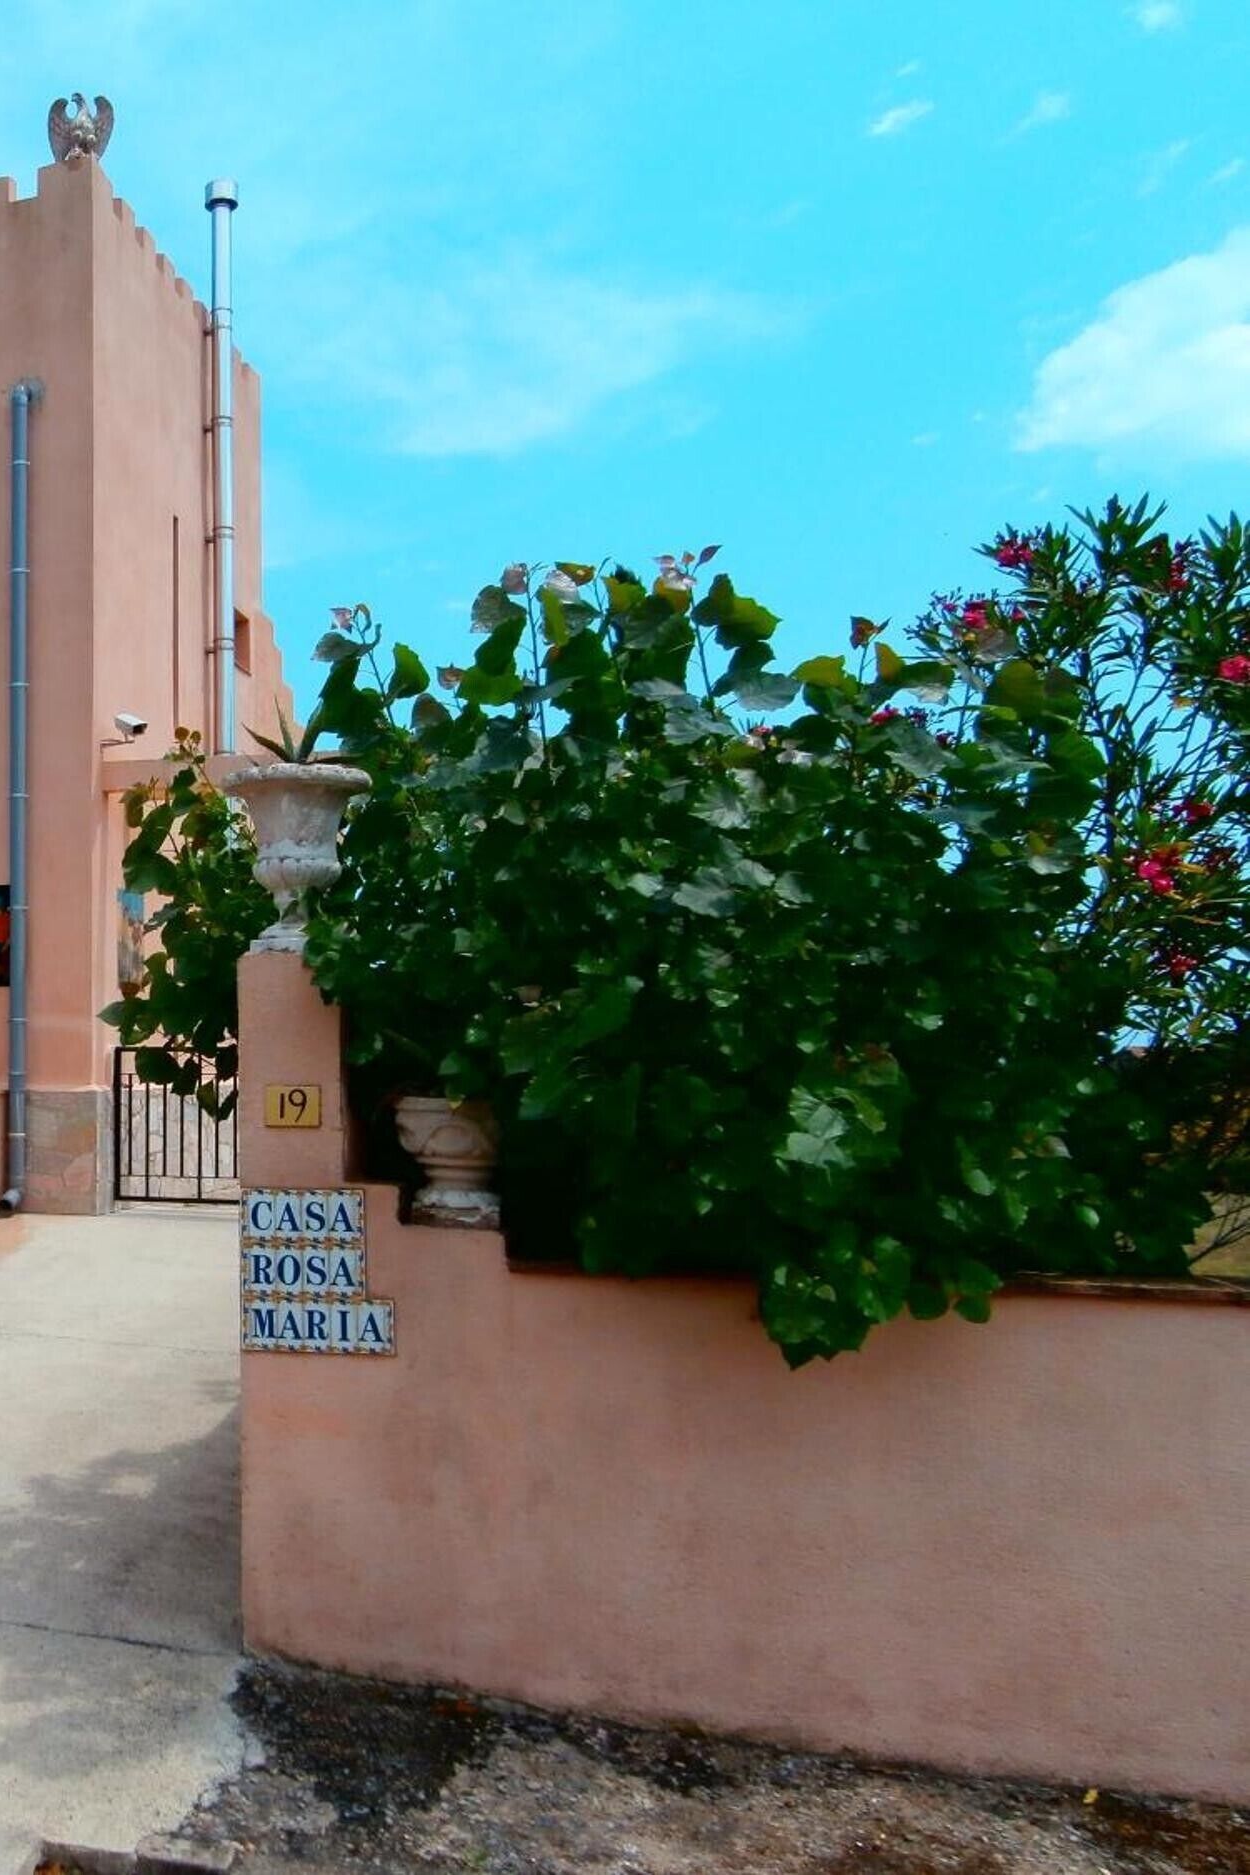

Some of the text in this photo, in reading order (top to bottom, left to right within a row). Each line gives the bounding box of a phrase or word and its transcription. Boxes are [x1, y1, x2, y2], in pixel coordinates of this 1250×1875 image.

[280, 1088, 307, 1123] 19
[251, 1201, 356, 1232] CASA
[251, 1254, 357, 1287] ROSA
[251, 1308, 385, 1343] MARIA
